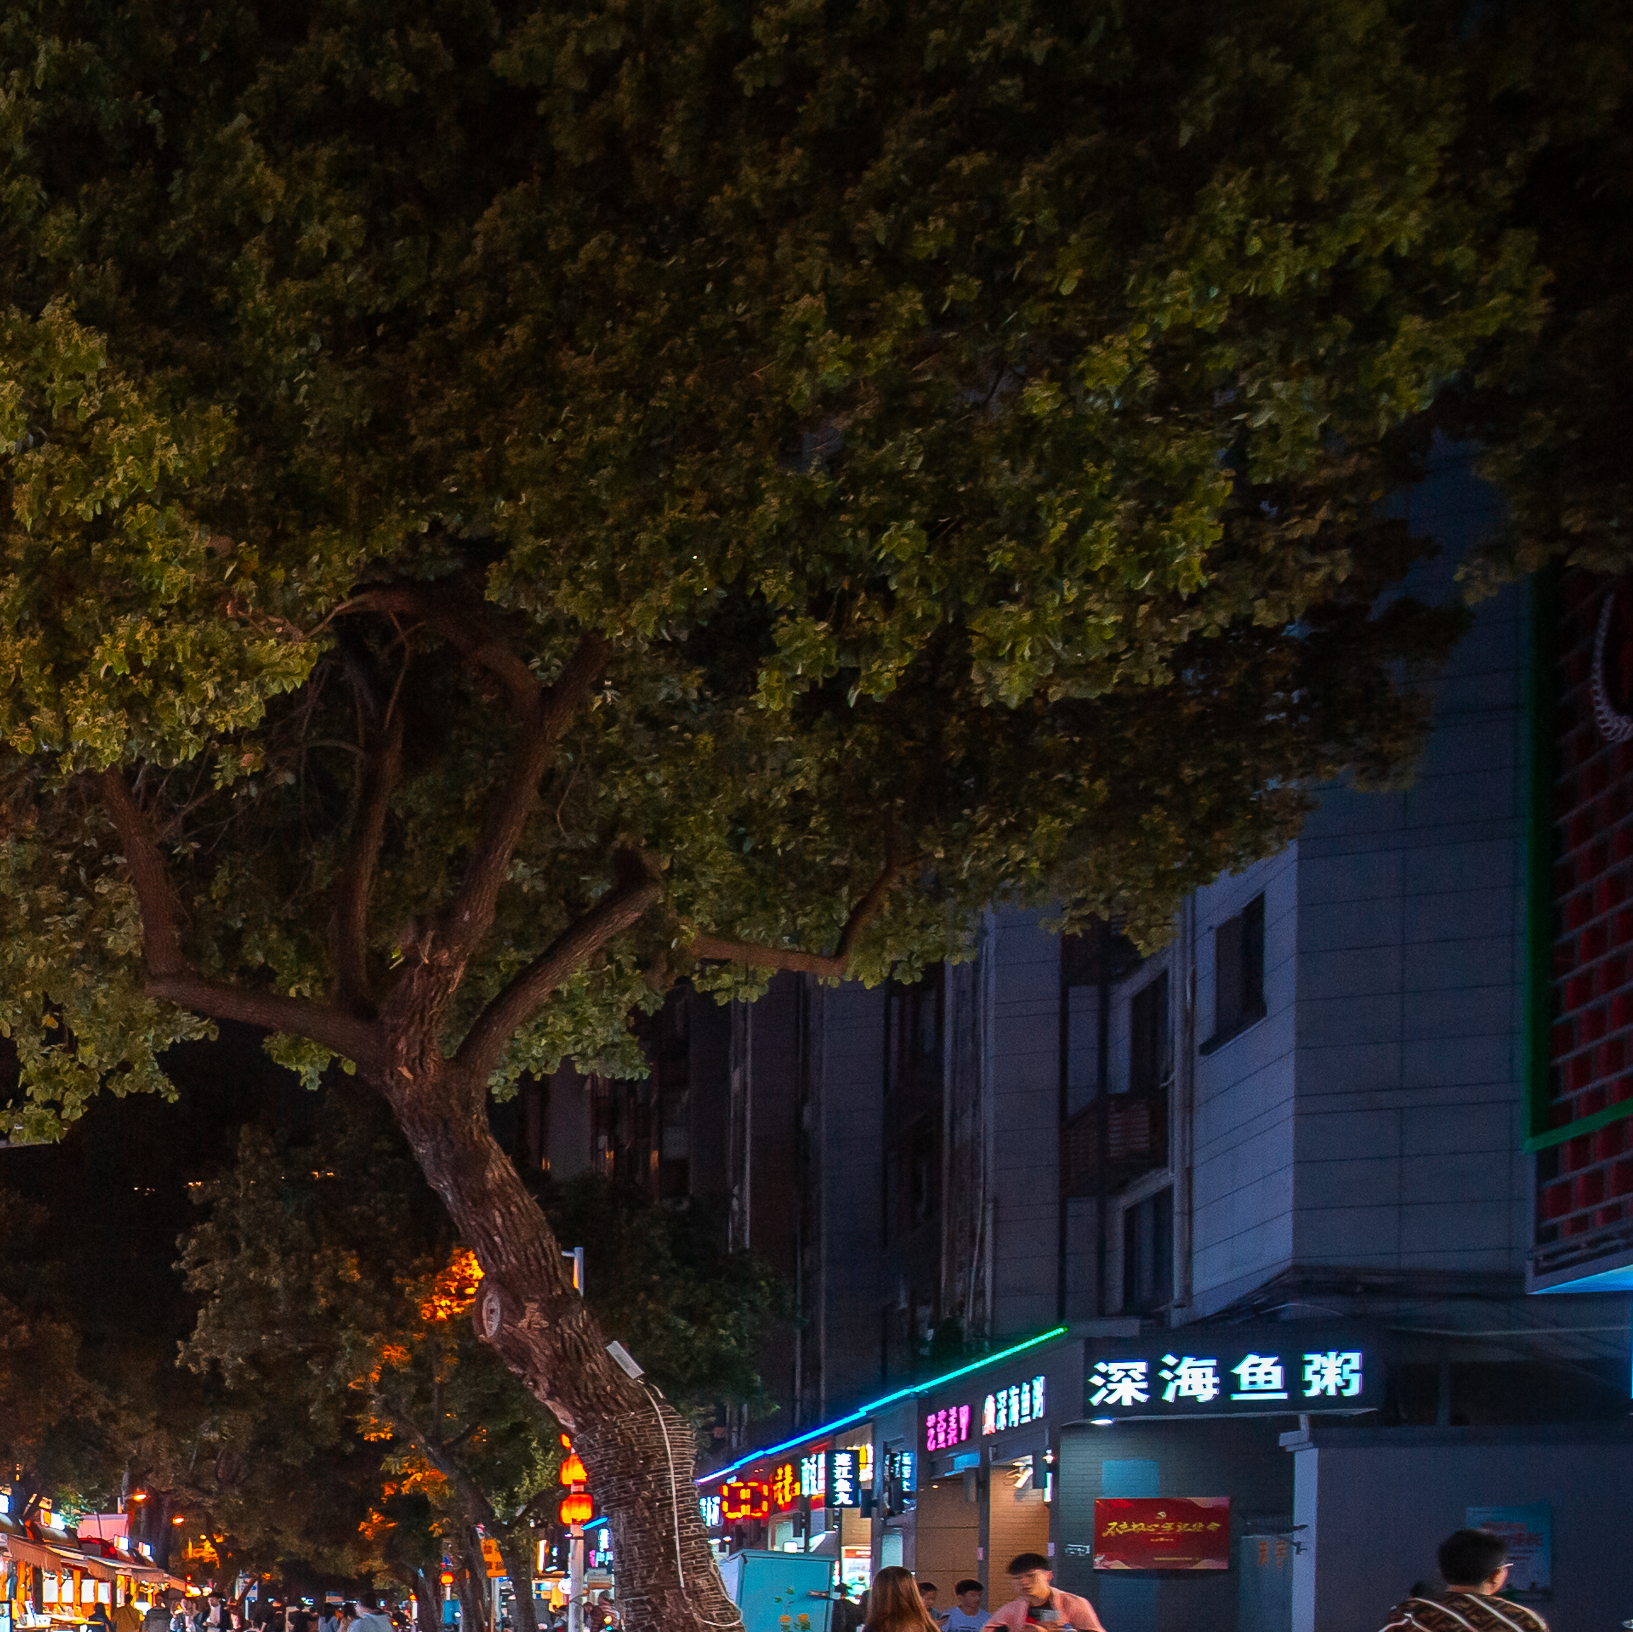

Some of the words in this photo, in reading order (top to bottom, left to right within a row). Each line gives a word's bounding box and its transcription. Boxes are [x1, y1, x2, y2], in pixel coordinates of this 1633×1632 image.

[996, 1376, 1045, 1431] 深海鱼粥
[1088, 1351, 1362, 1406] 深海鱼粥
